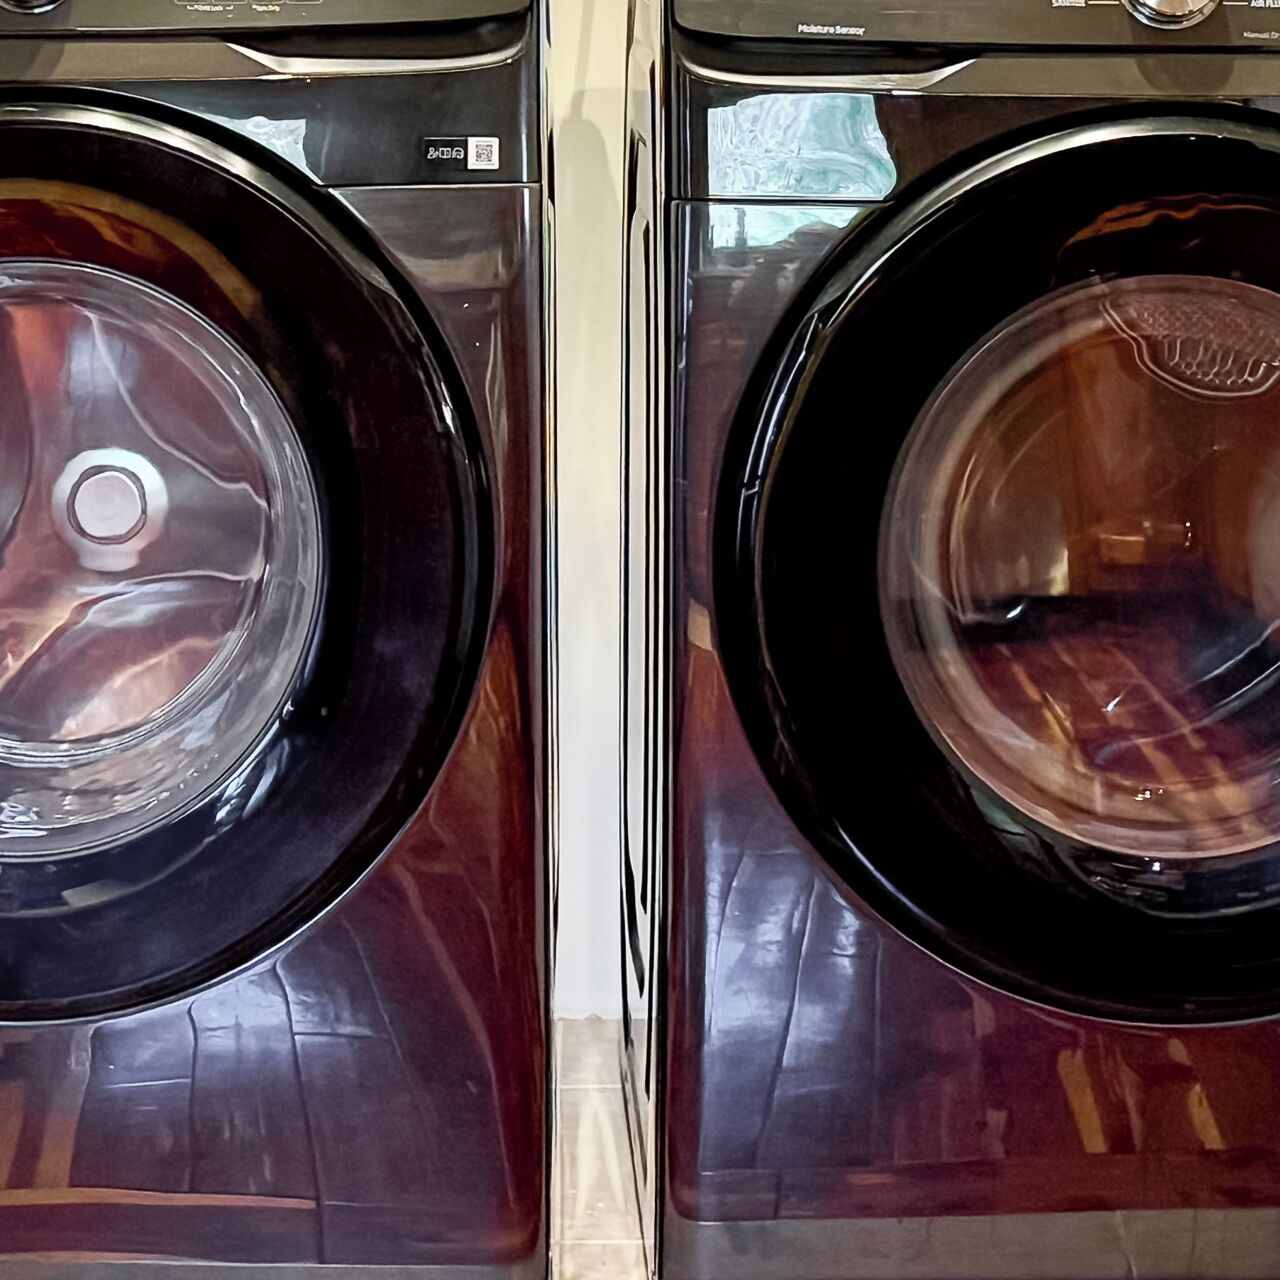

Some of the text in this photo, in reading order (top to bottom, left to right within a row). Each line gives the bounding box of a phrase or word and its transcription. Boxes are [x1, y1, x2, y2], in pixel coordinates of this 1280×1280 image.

[1250, 0, 1265, 8] AIR
[798, 24, 865, 36] Moisture Sensor
